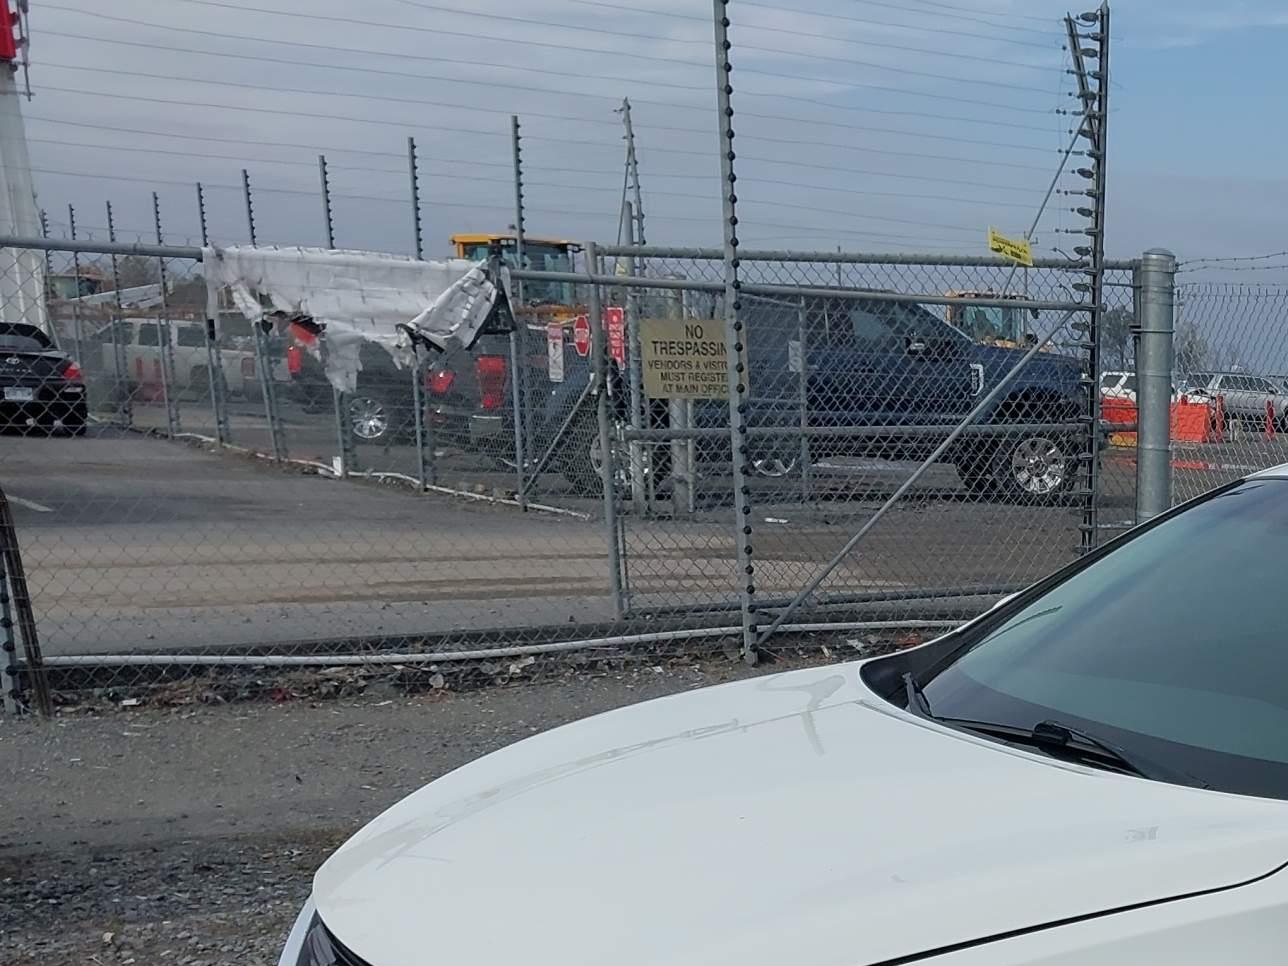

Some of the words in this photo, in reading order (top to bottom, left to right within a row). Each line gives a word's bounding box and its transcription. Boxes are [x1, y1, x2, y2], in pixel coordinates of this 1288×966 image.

[685, 325, 704, 339] NO
[652, 340, 728, 356] TRESPASSIN
[648, 360, 693, 370] VENDORS
[660, 372, 686, 382] MUST
[688, 372, 729, 383] REGISTE
[662, 383, 674, 393] AT
[676, 383, 699, 394] MAIN
[702, 384, 729, 394] OFFIC
